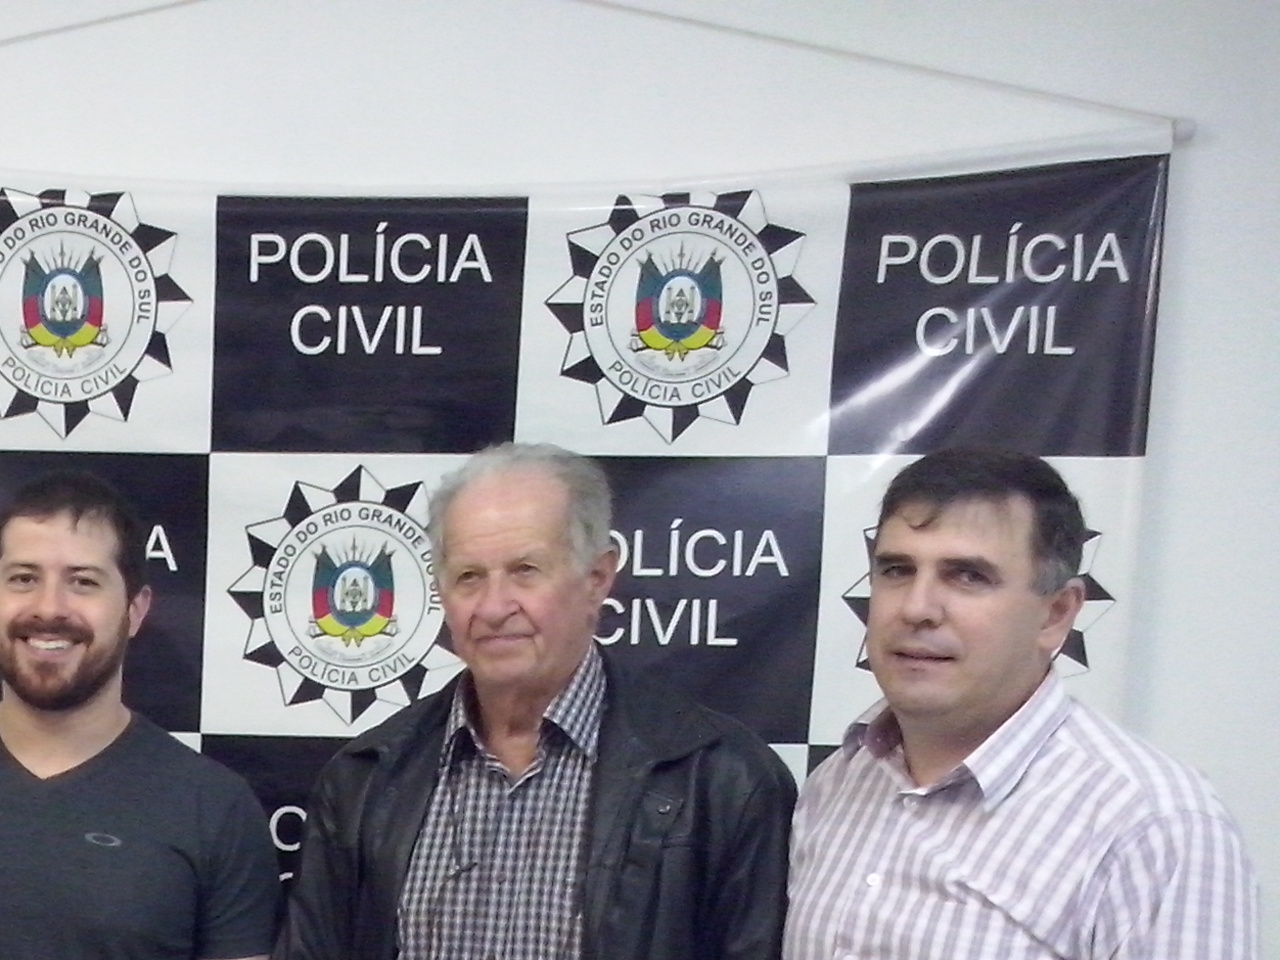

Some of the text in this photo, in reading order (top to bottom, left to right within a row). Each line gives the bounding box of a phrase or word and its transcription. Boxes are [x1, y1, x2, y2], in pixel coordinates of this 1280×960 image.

[3, 226, 26, 250] DO
[28, 213, 58, 233] RIO
[64, 212, 132, 255] GRANDE
[128, 256, 147, 283] DO
[249, 221, 492, 284] POLÍCIA
[590, 212, 773, 328] ESTADO DO RIO GRANDE DO SUL
[876, 222, 1130, 285] POLÍCIA
[135, 291, 151, 324] SUL
[290, 304, 442, 356] CIVIL
[915, 305, 1076, 358] CIVIL
[80, 363, 127, 395] CIVIL
[691, 365, 742, 398] CIVIL
[269, 544, 297, 615] ESTADO
[294, 521, 318, 543] DO
[322, 507, 352, 527] RIO
[358, 507, 425, 549] GRANDE
[609, 518, 789, 577] LÍCIA
[592, 598, 738, 646] CIVIL
[368, 652, 416, 683] CIVIL
